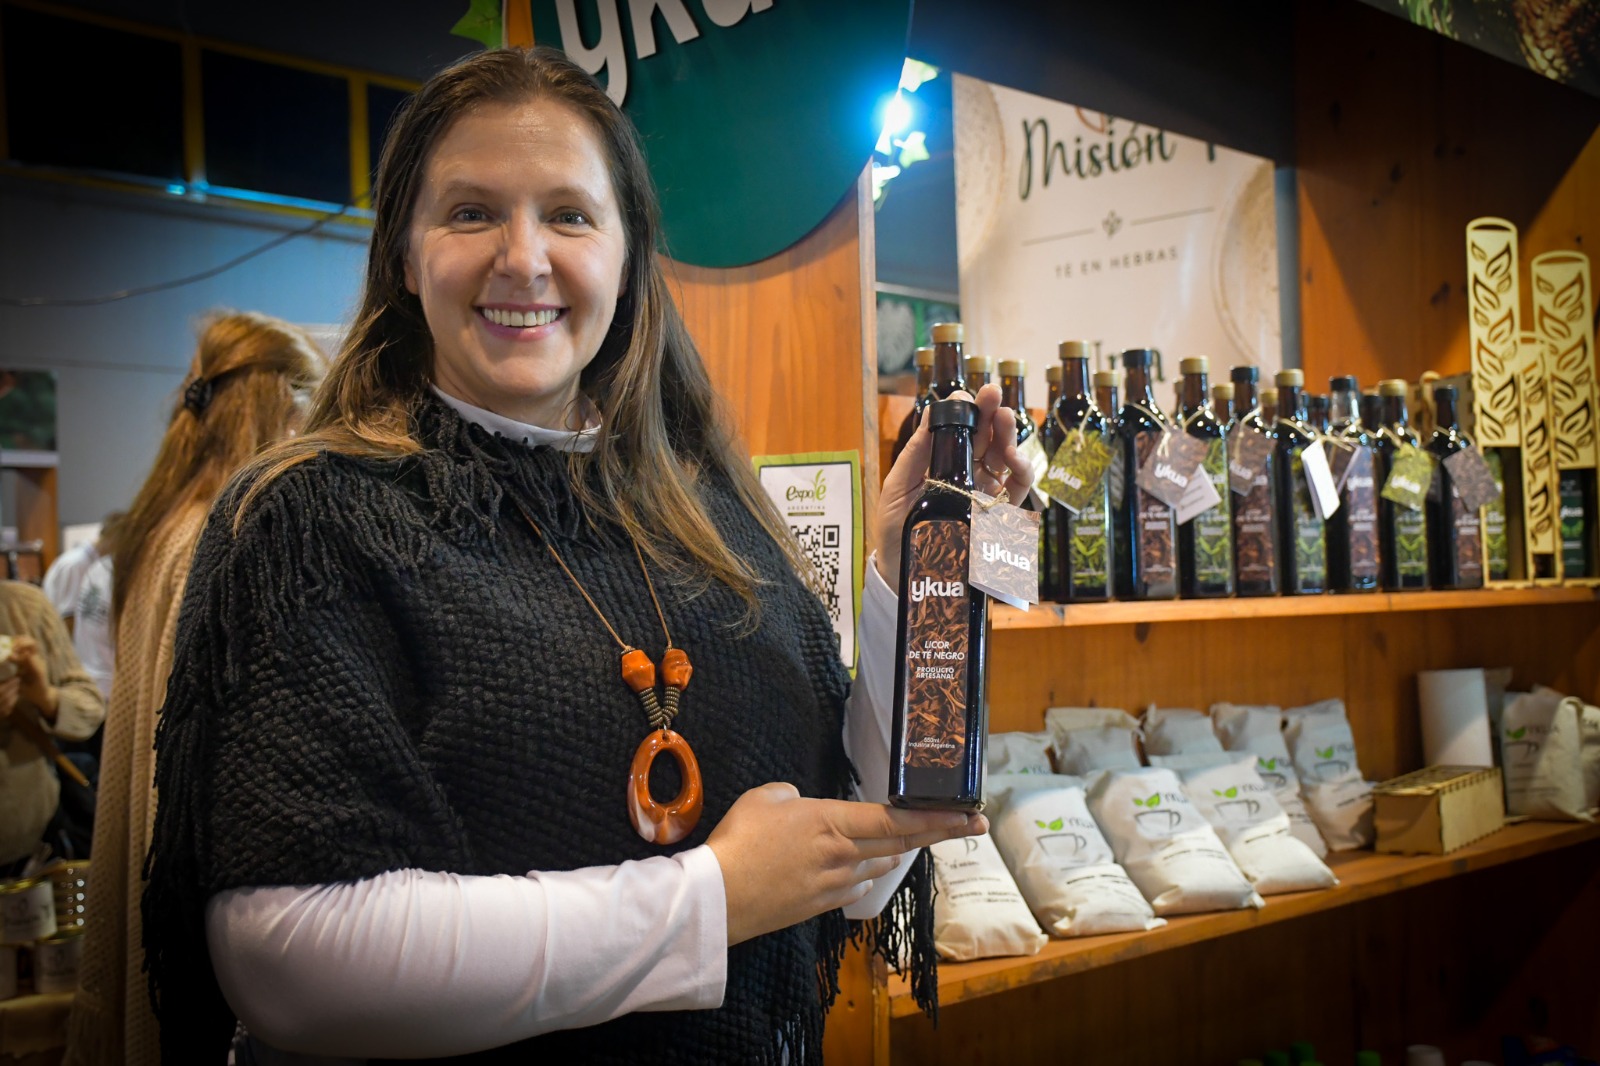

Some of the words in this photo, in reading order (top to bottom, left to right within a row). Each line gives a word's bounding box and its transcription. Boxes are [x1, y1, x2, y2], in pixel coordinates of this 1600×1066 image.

[1080, 259, 1102, 275] EN
[1109, 246, 1179, 270] HEBRAS
[982, 541, 1031, 571] ykua
[911, 576, 964, 602] ykua
[924, 640, 950, 649] LICOR
[908, 650, 920, 659] DE
[922, 650, 932, 660] TÉ
[933, 652, 965, 660] NEGRO
[916, 666, 955, 674] PRODUCTO
[930, 742, 956, 750] Argentina
